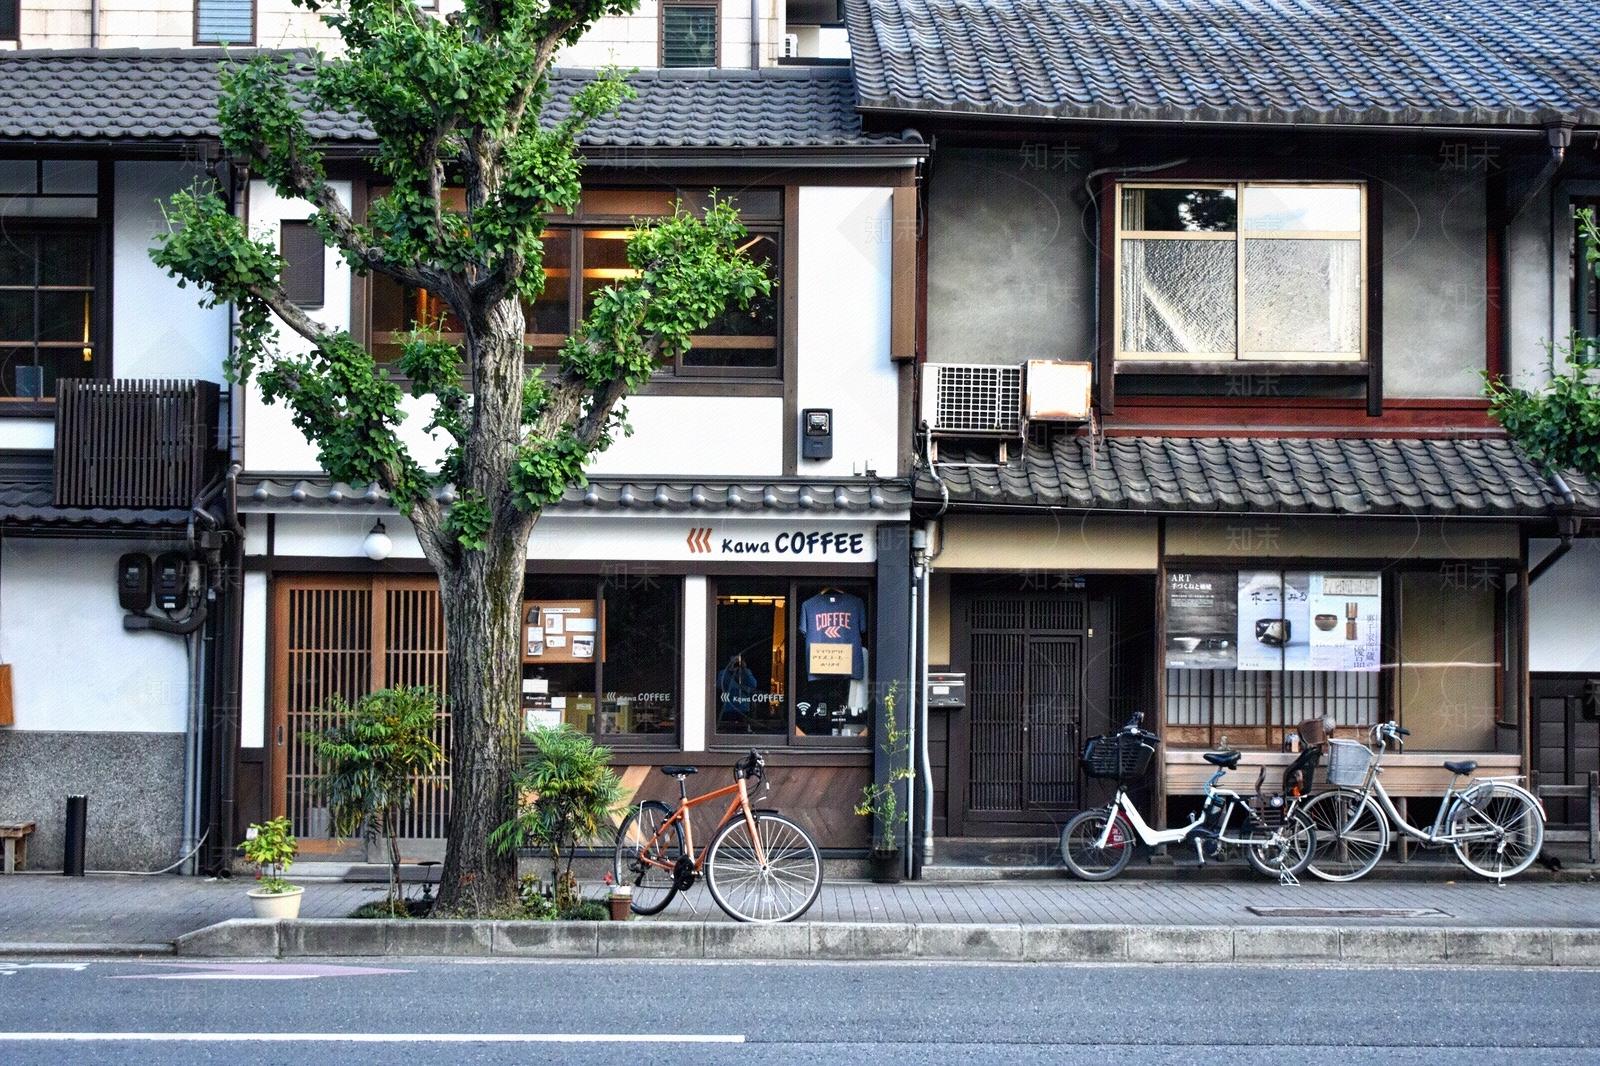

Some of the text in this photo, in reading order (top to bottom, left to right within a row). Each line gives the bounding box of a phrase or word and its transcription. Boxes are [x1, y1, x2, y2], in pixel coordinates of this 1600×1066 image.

[722, 531, 864, 554] Kawa COFFEE
[1171, 573, 1191, 582] ART
[815, 612, 851, 631] COFFEE
[638, 692, 671, 702] COFFEE
[752, 693, 785, 703] COFFEE
